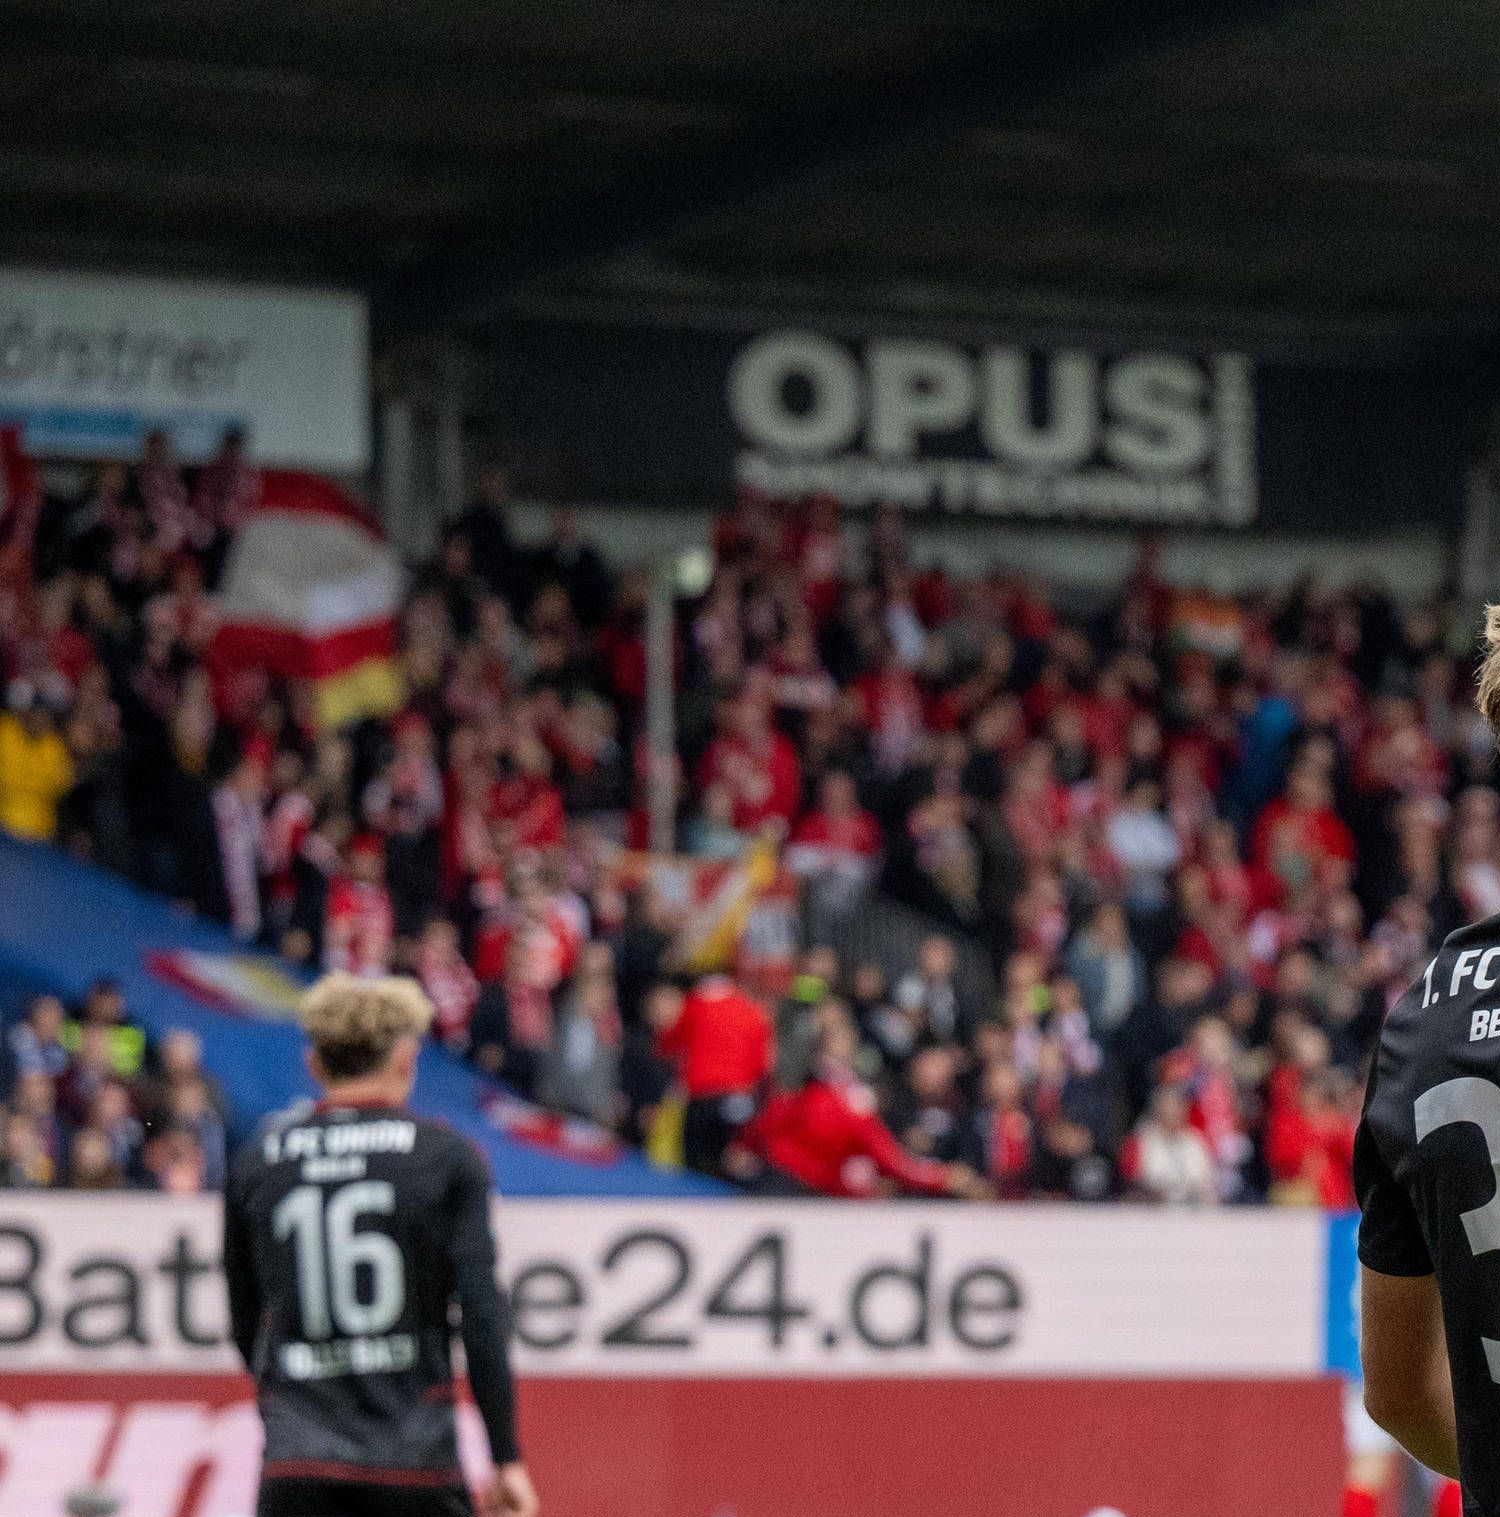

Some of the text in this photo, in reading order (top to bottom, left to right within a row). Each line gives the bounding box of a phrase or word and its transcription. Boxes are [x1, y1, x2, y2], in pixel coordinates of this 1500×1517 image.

[728, 327, 1211, 474] OPUS
[0, 1222, 1024, 1350] Bate24.de
[271, 1178, 406, 1342] 16
